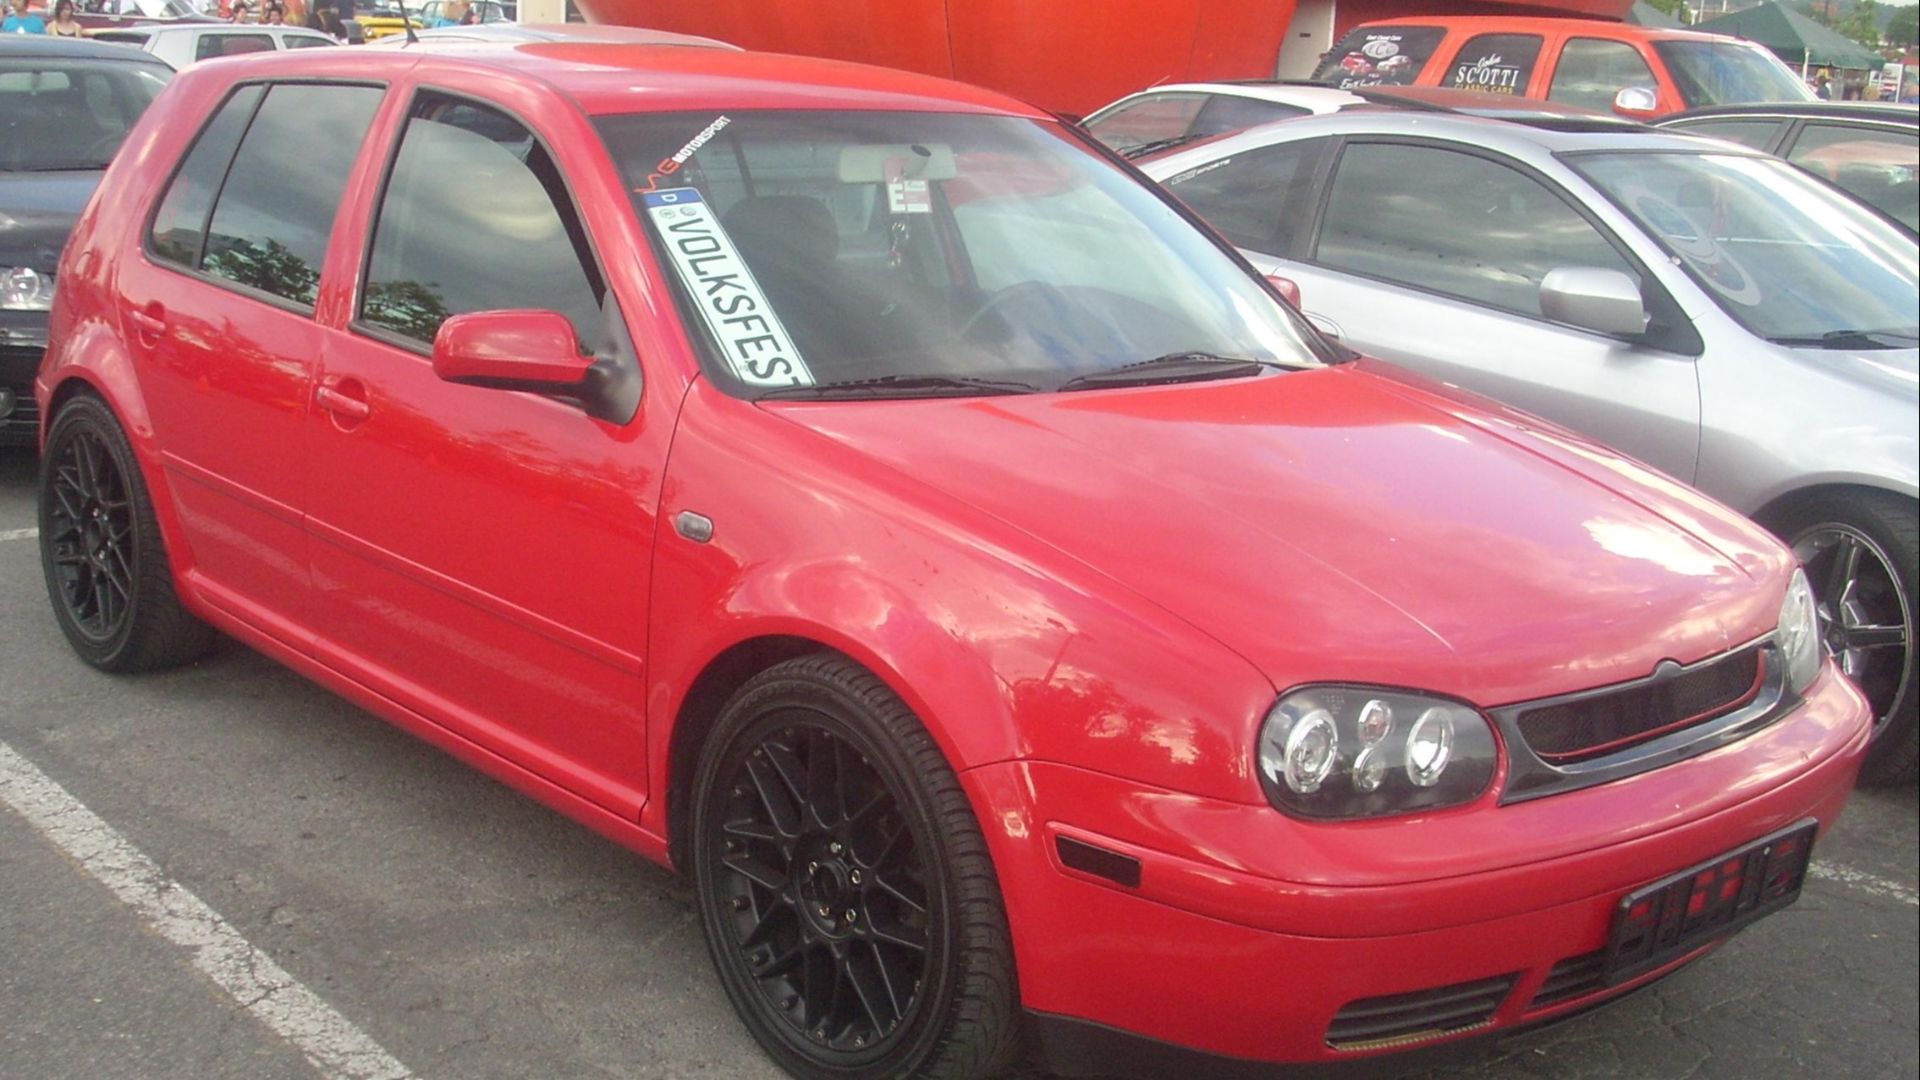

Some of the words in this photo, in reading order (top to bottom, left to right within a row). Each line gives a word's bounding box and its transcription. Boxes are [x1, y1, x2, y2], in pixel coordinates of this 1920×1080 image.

[1455, 65, 1519, 87] SCOTTI
[671, 115, 731, 164] MOTORSPORT
[661, 193, 678, 202] D
